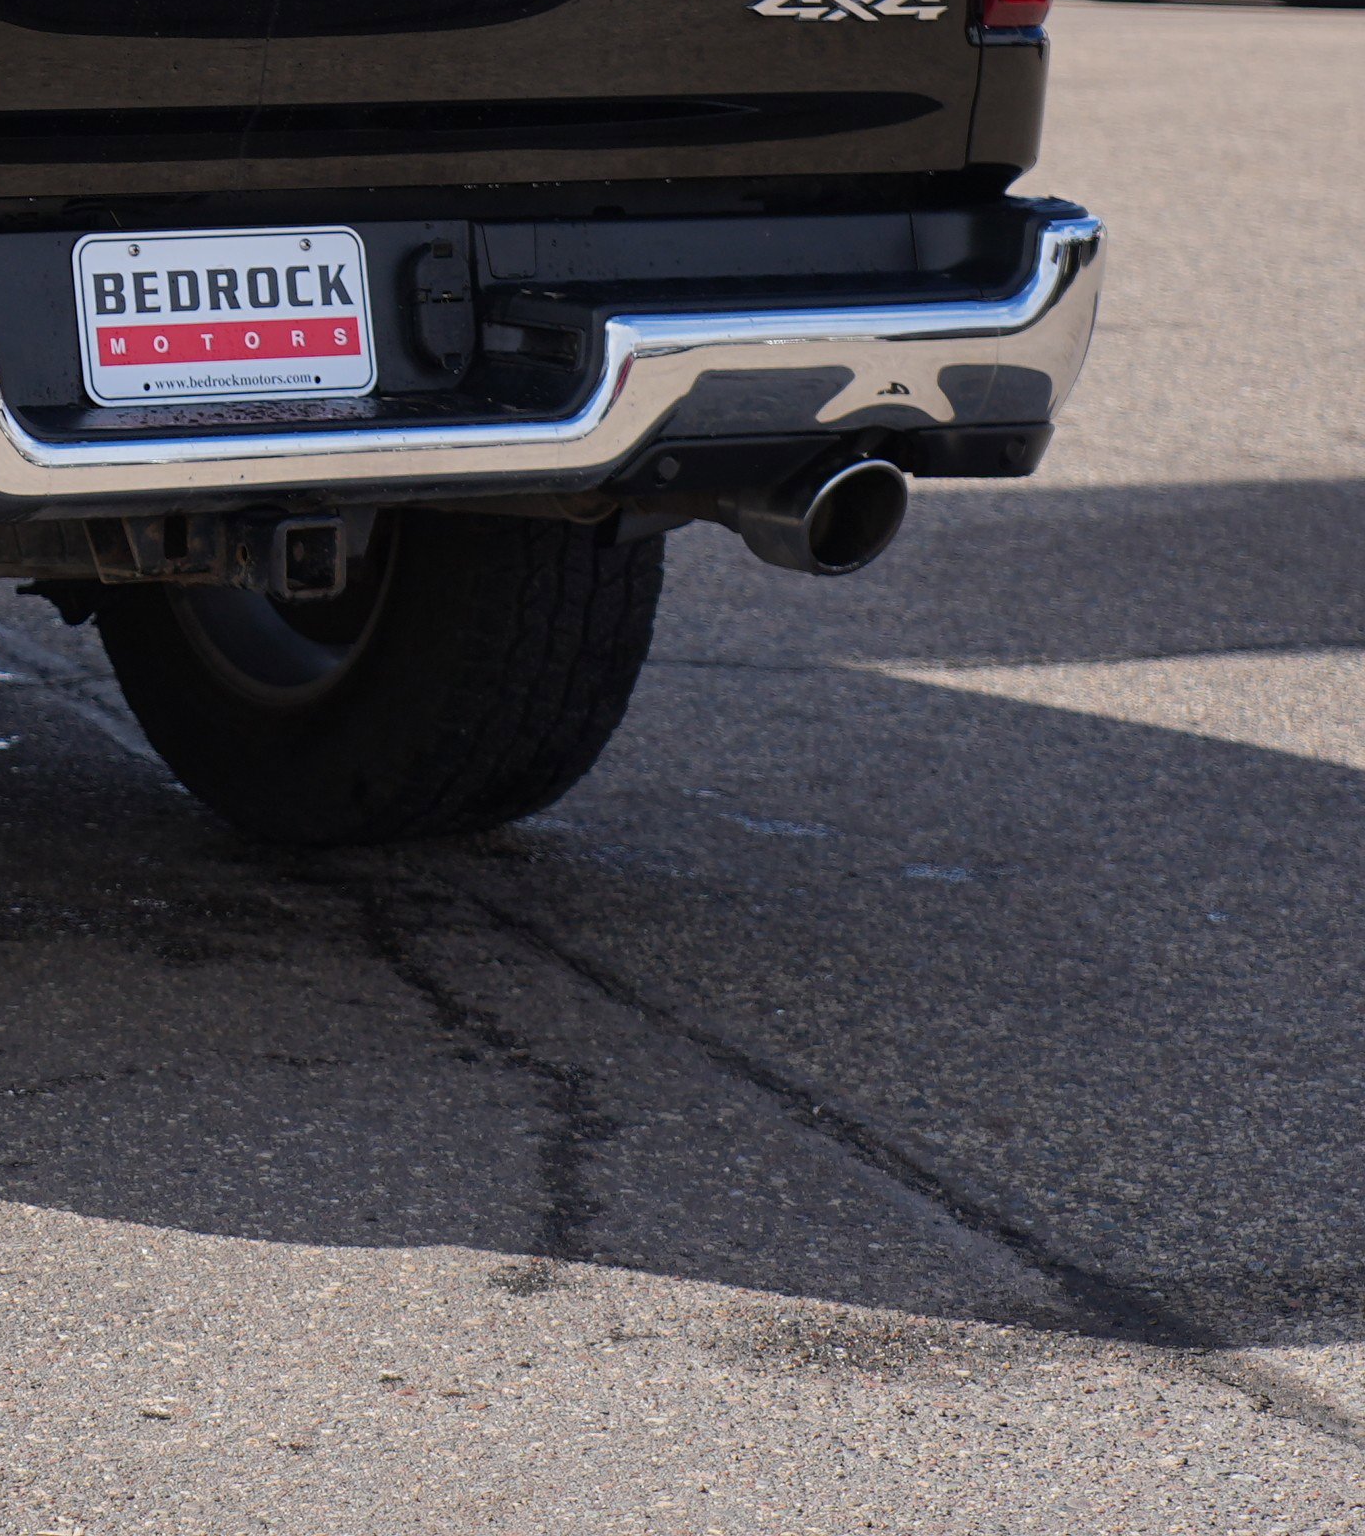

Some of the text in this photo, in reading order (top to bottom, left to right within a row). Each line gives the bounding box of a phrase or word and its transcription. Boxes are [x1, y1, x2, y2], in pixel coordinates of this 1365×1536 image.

[92, 264, 354, 315] BEDROCK
[110, 327, 348, 355] MOTORS
[154, 373, 312, 390] www.bedrockmotors.com
